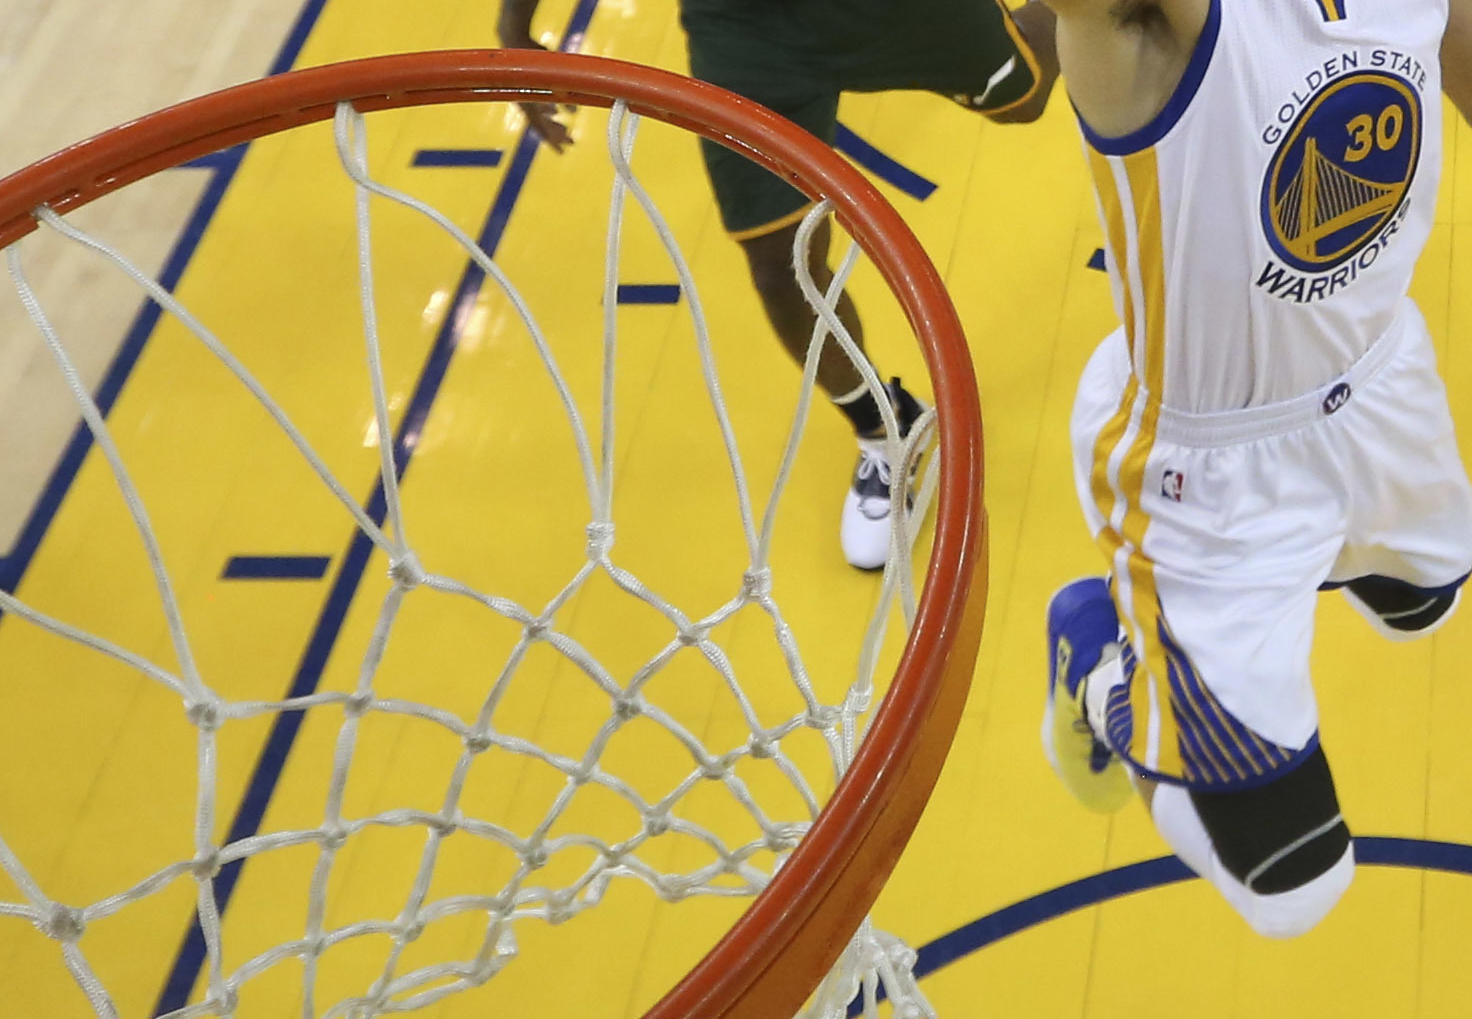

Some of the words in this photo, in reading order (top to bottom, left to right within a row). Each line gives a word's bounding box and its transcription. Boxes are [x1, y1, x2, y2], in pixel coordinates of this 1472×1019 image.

[1263, 51, 1358, 145] GOLDEN
[1370, 49, 1427, 92] STATE
[1344, 104, 1404, 162] 30
[1256, 197, 1411, 303] WARRIORS
